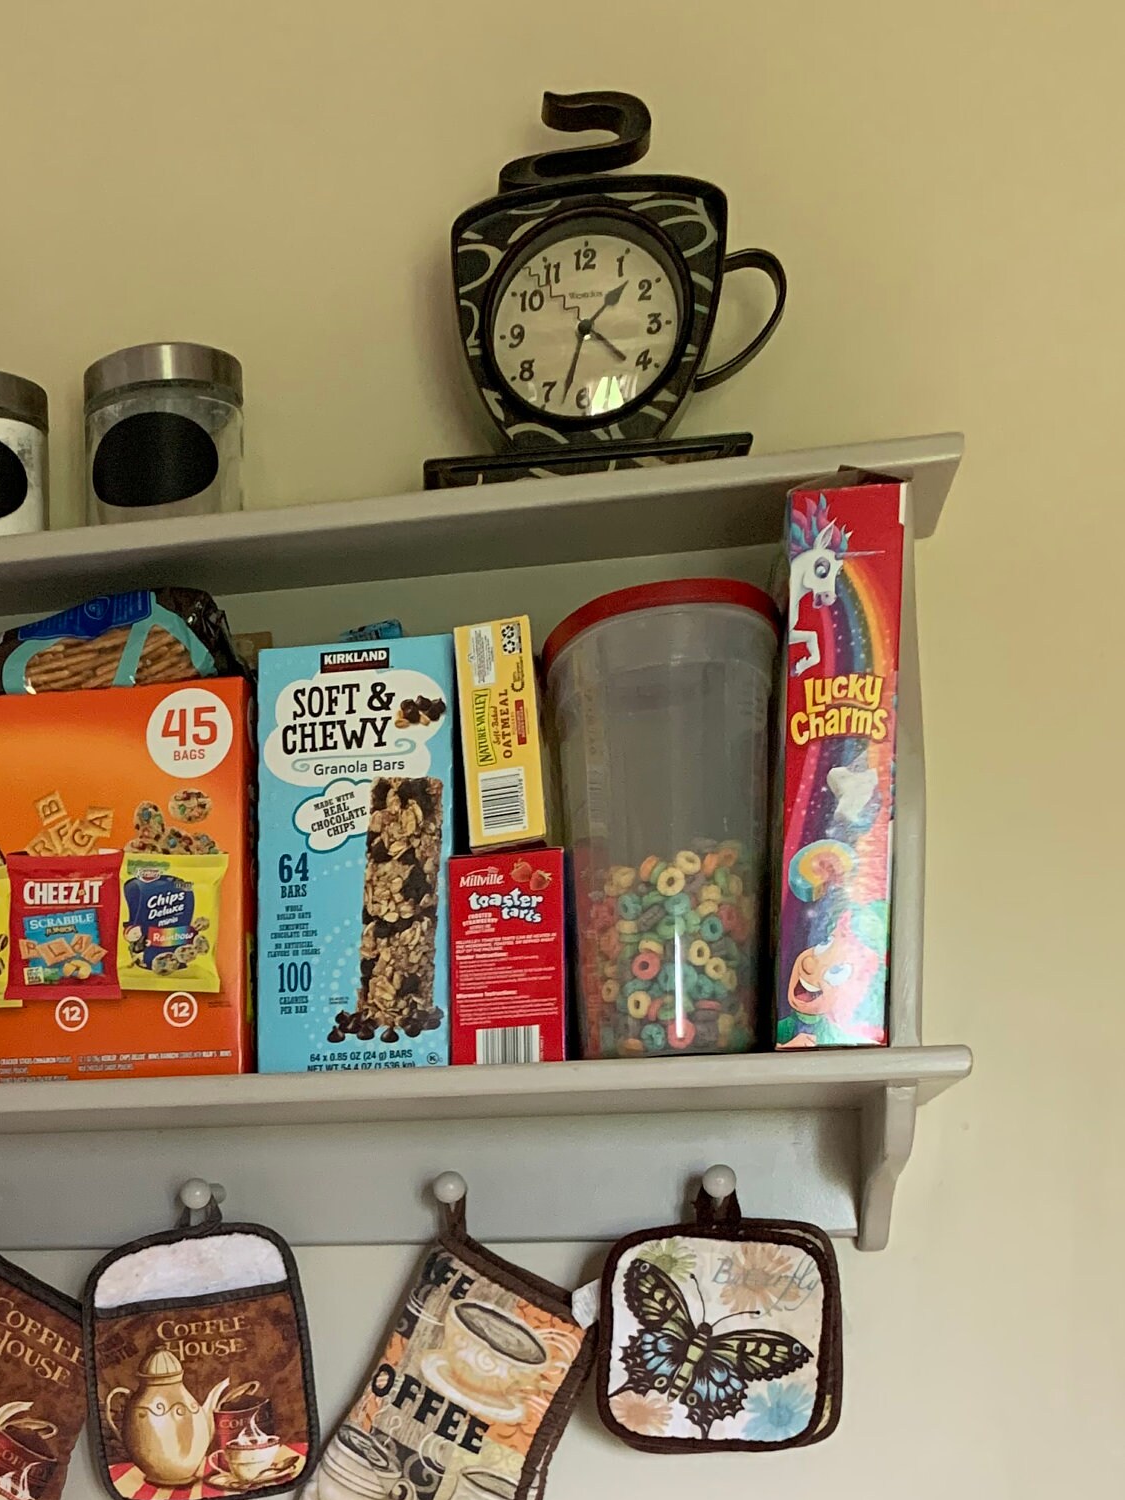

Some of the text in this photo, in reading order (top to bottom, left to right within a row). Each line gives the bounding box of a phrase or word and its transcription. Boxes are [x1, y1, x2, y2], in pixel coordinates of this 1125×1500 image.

[574, 248, 596, 271] 12
[616, 255, 625, 277] 1
[544, 261, 560, 284] 11
[520, 290, 544, 312] 10
[638, 279, 652, 301] 2
[646, 313, 661, 335] 3
[509, 324, 524, 348] 9
[519, 359, 535, 382] 8
[635, 349, 652, 371] 4
[542, 381, 557, 403] 7
[324, 650, 387, 666] KIRKLAND
[293, 682, 395, 721] SOFT &
[804, 674, 883, 714] Lucky
[475, 693, 488, 727] VALLEY
[161, 706, 218, 747] 45
[499, 689, 513, 759] OATMEAL
[790, 706, 888, 746] Charms
[282, 716, 392, 755] CHEWY
[477, 727, 493, 763] NATURE
[173, 749, 206, 761] BAGS
[313, 759, 405, 776] Granola Bars
[313, 791, 355, 811] MADE WITH
[323, 802, 350, 818] REAL
[311, 806, 367, 833] CHOCOLATE
[327, 821, 356, 838] CHIPS
[278, 852, 309, 884] 64
[280, 884, 307, 899] BARS
[459, 873, 504, 888] Millville
[23, 880, 104, 905] CHEEZ-IT
[147, 891, 185, 909] Chips
[468, 887, 544, 910] toaster
[29, 913, 95, 930] SCRABBLE
[148, 904, 185, 920] Deluxe
[158, 916, 179, 927] minis
[501, 906, 542, 923] tarts
[153, 932, 194, 942] Rainbow
[270, 929, 318, 940] CHOCOLATE CHIPS
[278, 961, 312, 993] 100
[170, 1002, 190, 1018] 12
[279, 995, 309, 1005] CALORIES
[280, 1005, 308, 1015] PER BAR
[61, 1006, 82, 1022] 12
[309, 1053, 320, 1062] 64
[329, 1052, 347, 1061] 0.85
[350, 1051, 361, 1060] OZ
[363, 1050, 375, 1061] (24
[378, 1050, 387, 1061] g)
[389, 1049, 413, 1059] BARS
[157, 1315, 251, 1341] COFFEE
[164, 1337, 248, 1361] HOUSE
